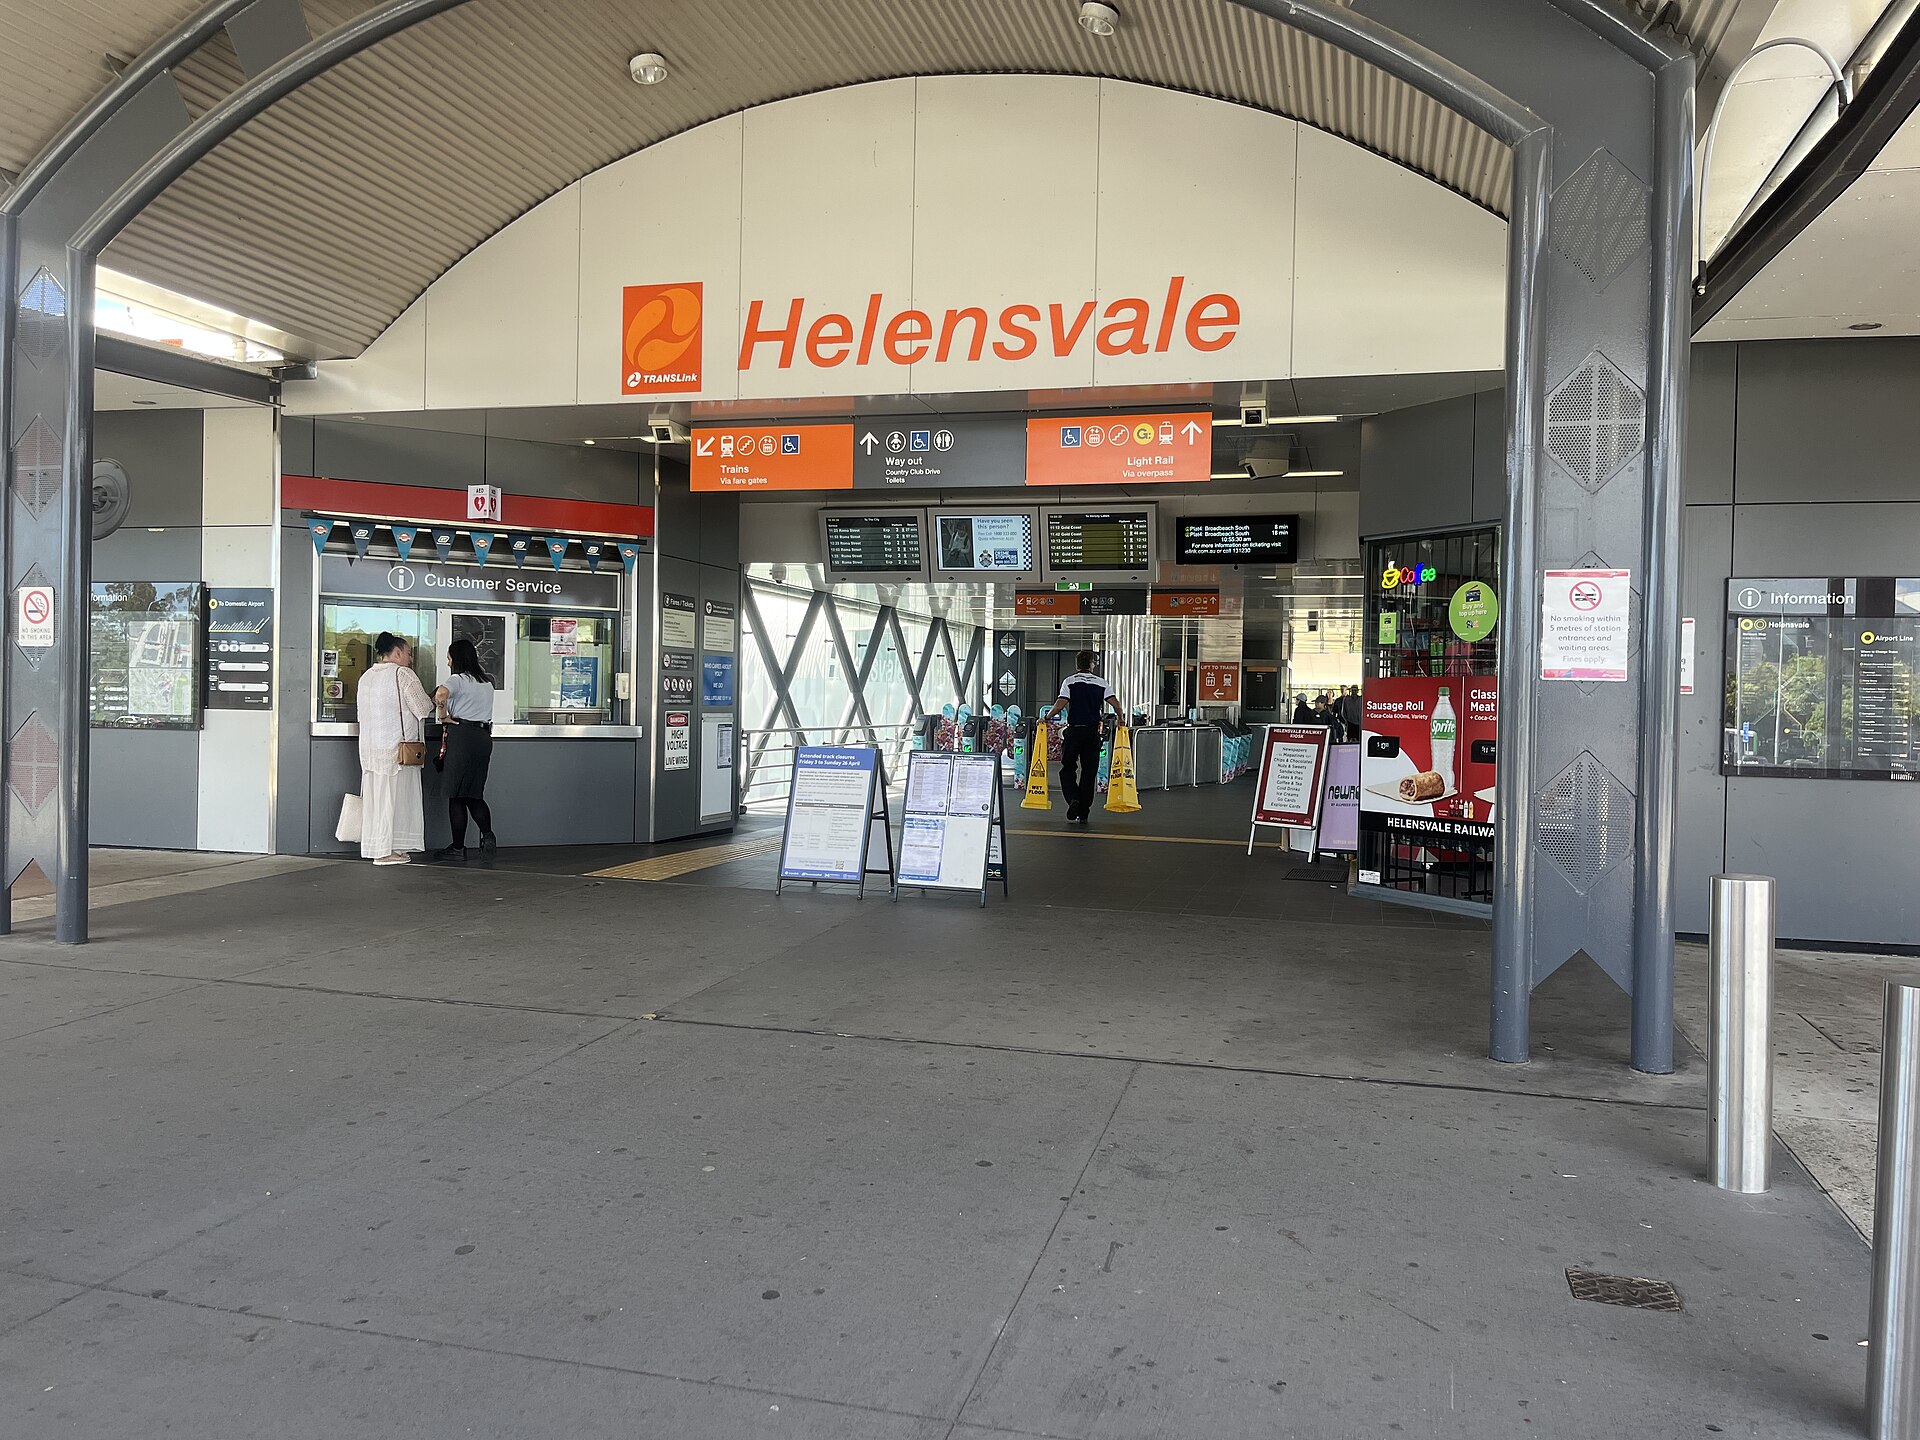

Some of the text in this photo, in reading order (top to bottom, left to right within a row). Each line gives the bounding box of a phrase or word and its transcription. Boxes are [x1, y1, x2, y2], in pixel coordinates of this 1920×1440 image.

[738, 276, 1241, 371] Helensvale
[643, 373, 698, 384] TRANSLink
[885, 457, 923, 467] Way out
[1127, 455, 1174, 468] Light Rail
[720, 465, 749, 474] Trains
[885, 469, 909, 477] Country
[1122, 469, 1174, 478] Via overpass
[720, 477, 768, 486] Via fare gates
[424, 573, 562, 594] Customer Service
[670, 598, 694, 608] Fares Tickets
[1770, 592, 1854, 605] Information
[1562, 615, 1595, 624] smoking
[1558, 645, 1588, 653] waiting
[1470, 689, 1496, 700] Class
[1366, 700, 1424, 712] Sausage Roll
[1470, 702, 1495, 712] Meat
[1432, 720, 1456, 735] Sprite
[671, 730, 684, 740] HIGH
[666, 740, 688, 751] VOLTAGE
[666, 755, 688, 766] LIVE WIRES
[1387, 817, 1452, 833] HELENSVALE
